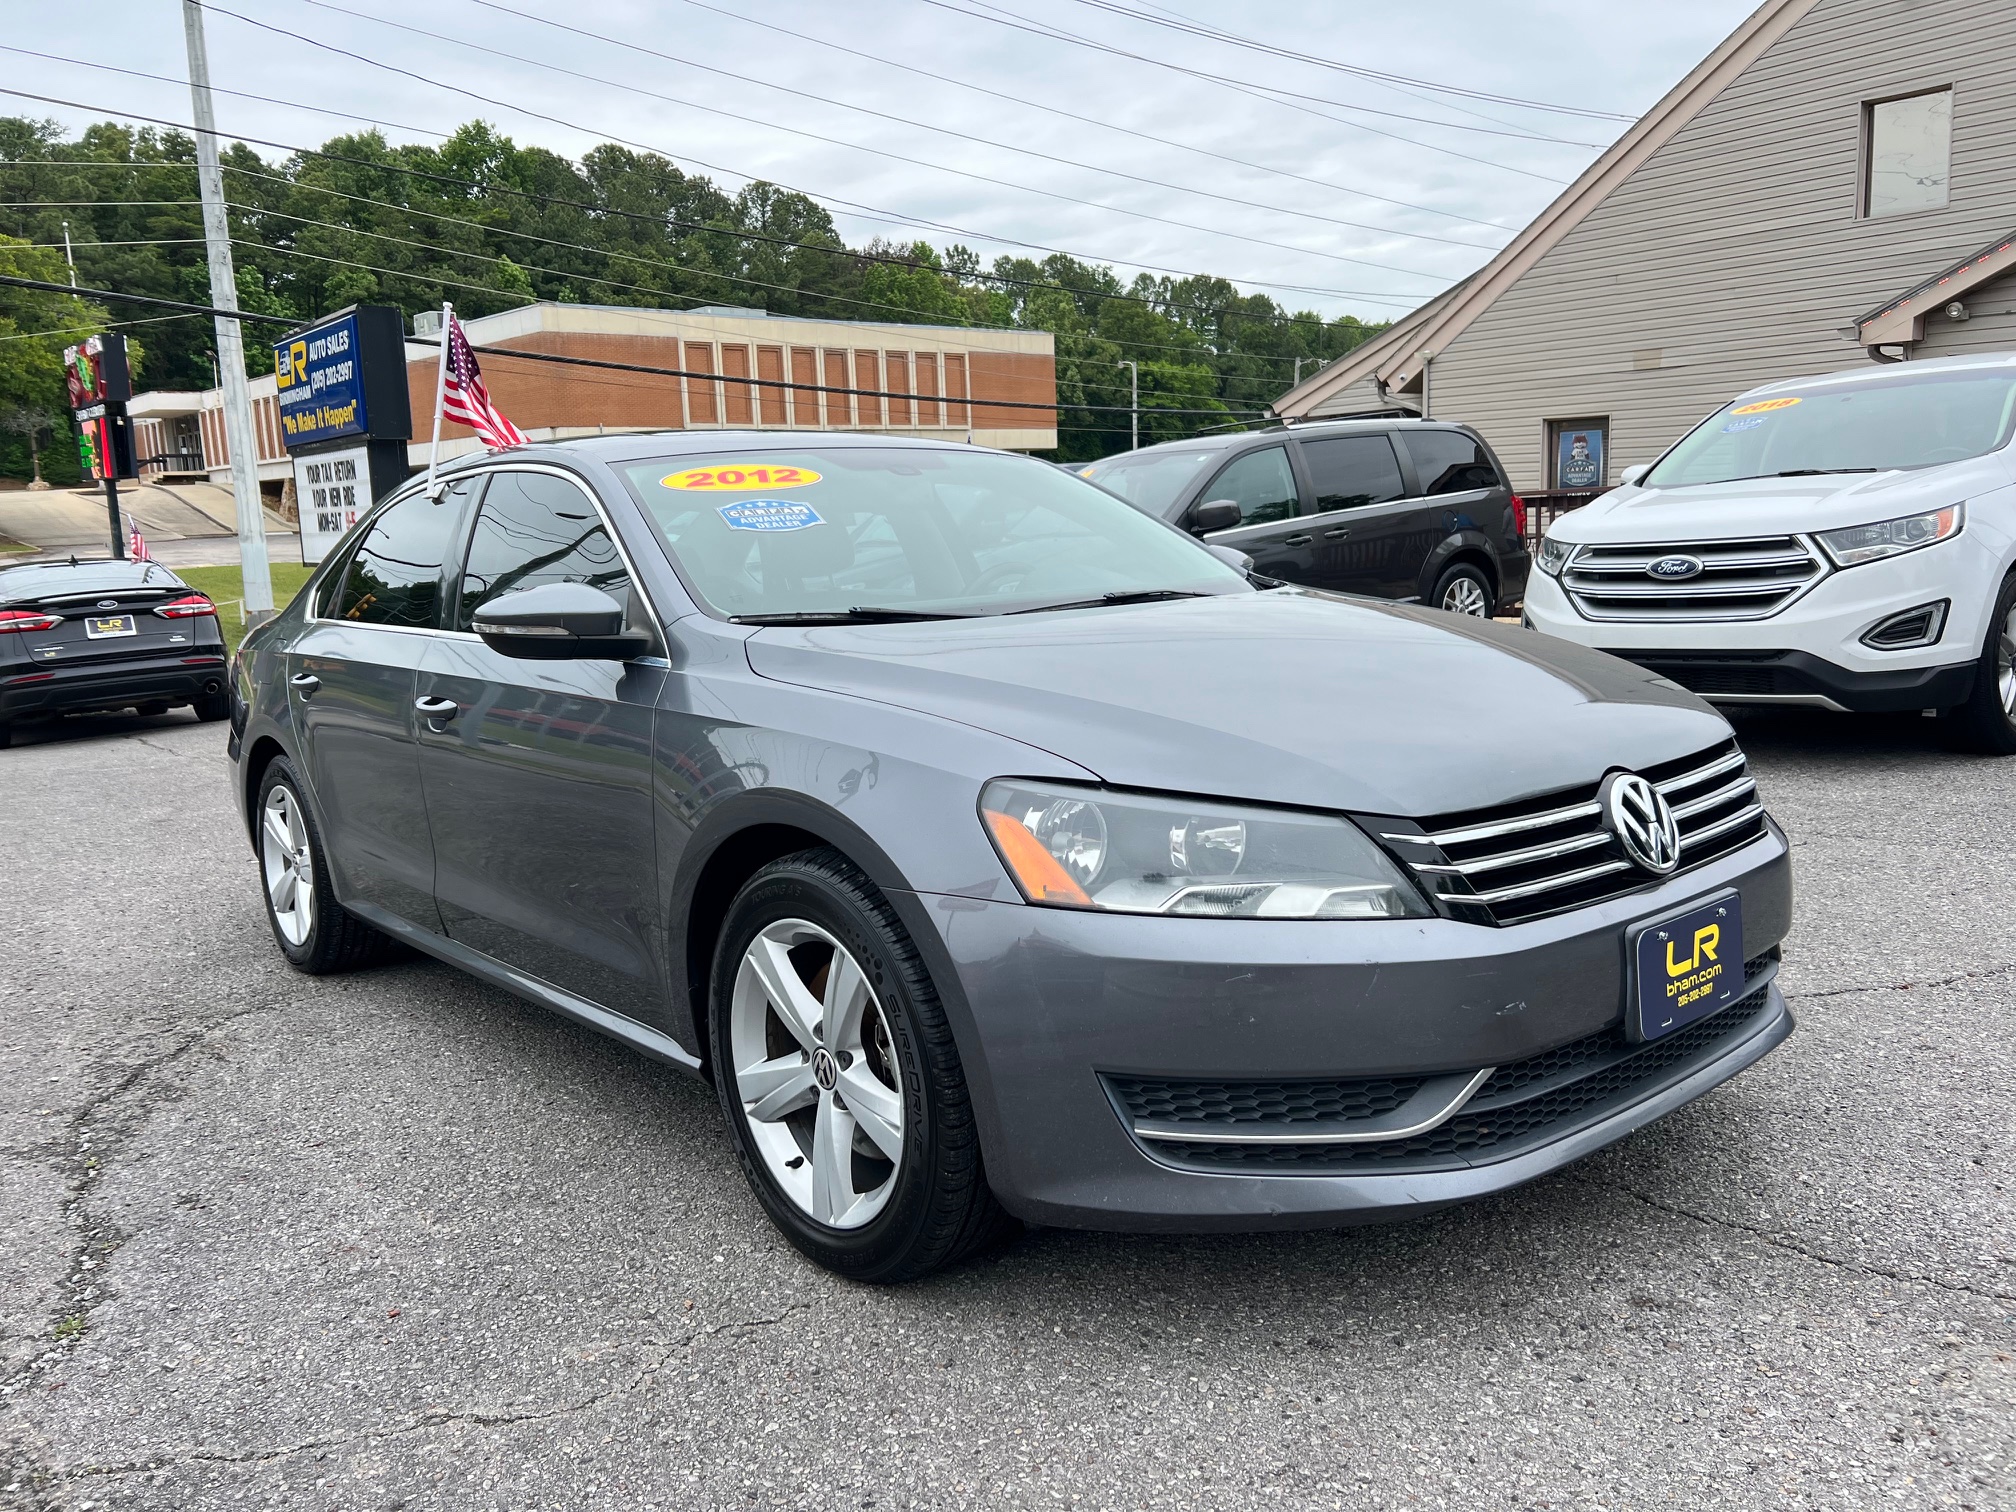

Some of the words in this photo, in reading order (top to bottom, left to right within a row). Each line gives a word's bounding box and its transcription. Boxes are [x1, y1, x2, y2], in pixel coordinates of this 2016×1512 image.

[309, 339, 326, 362] AUTO
[327, 329, 350, 356] SALES
[274, 340, 308, 389] LR
[311, 369, 326, 394] (205)
[326, 360, 353, 386] 202-2997
[296, 411, 317, 433] Make
[316, 408, 324, 428] It
[306, 464, 321, 484] YOUR
[321, 462, 333, 483] TAX
[333, 459, 356, 481] RETURN
[685, 469, 804, 488] 2012
[312, 488, 327, 508] YOUR
[329, 487, 342, 507] NEW
[342, 485, 356, 506] RIDE
[317, 512, 342, 532] MON-SAT
[727, 507, 810, 518] CARFAX
[740, 514, 809, 524] ADVANTAGE
[756, 521, 802, 529] DEALER
[1657, 560, 1689, 575] Ford
[97, 619, 123, 628] LR
[1666, 923, 1720, 978] LR
[1666, 963, 1722, 997] bham.com
[886, 993, 923, 1157] SUREDRIVE
